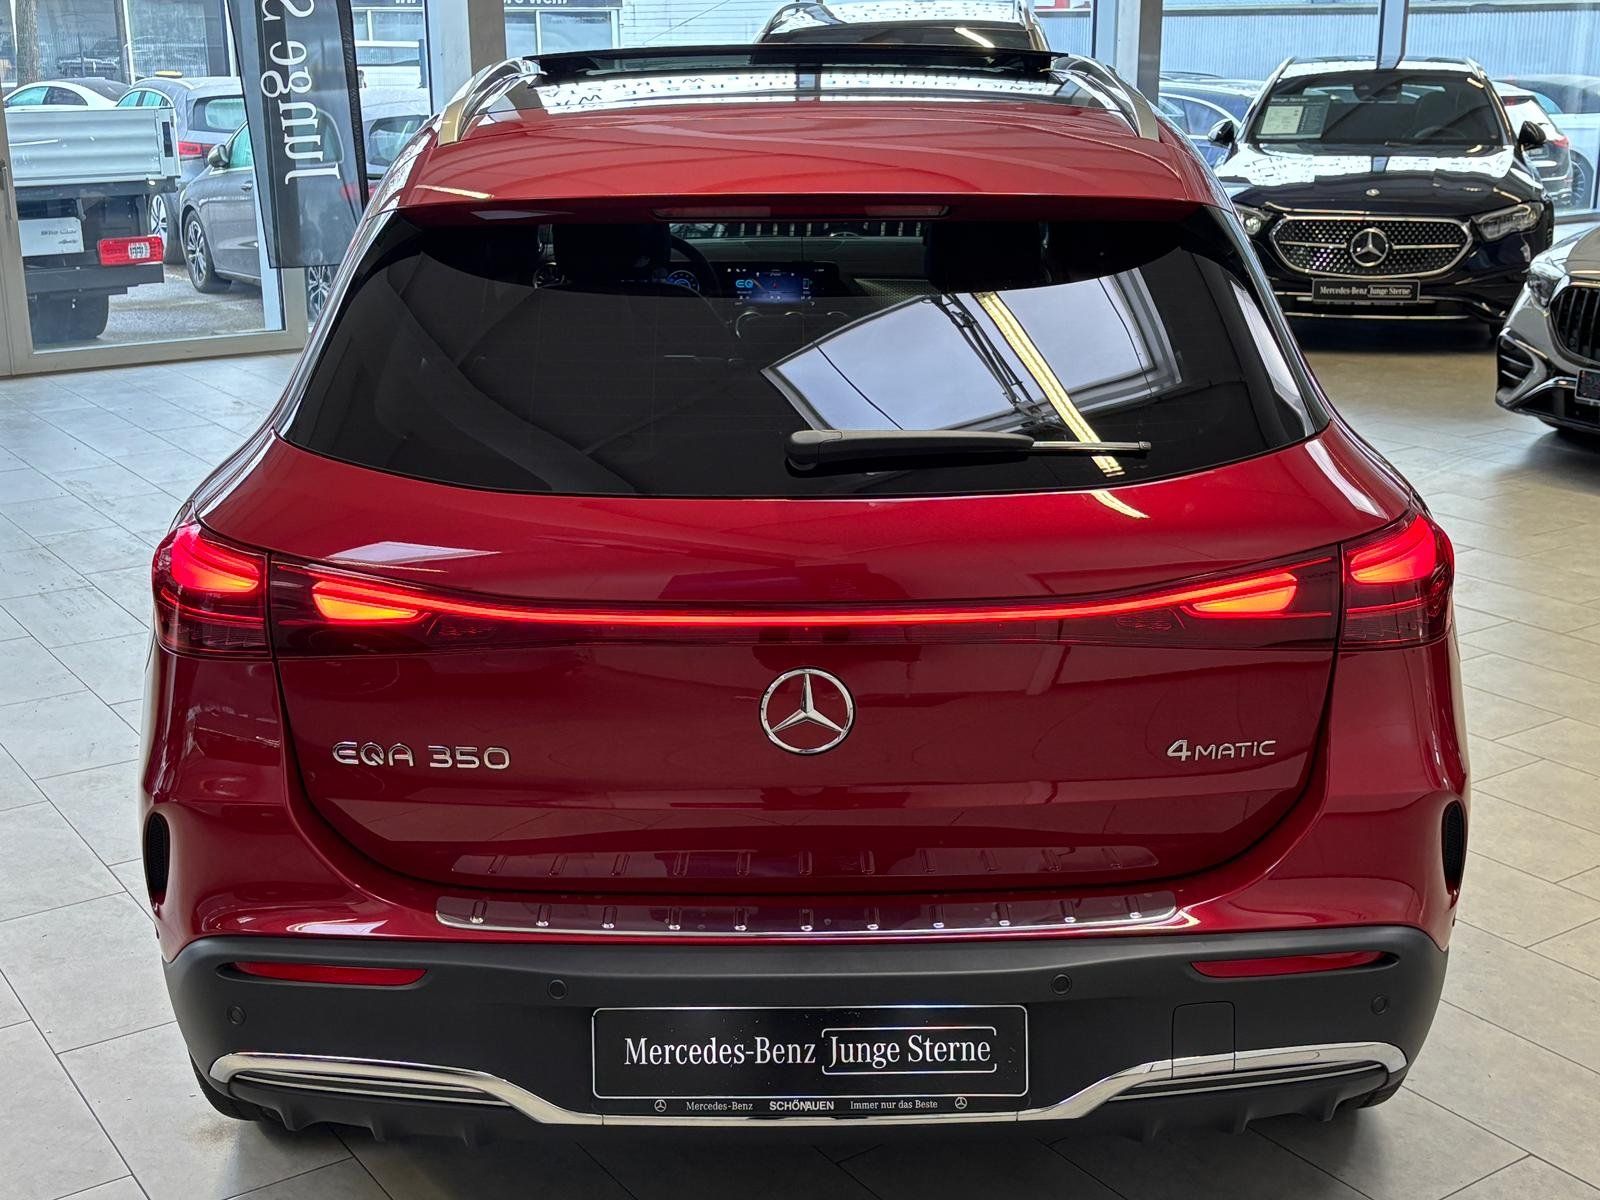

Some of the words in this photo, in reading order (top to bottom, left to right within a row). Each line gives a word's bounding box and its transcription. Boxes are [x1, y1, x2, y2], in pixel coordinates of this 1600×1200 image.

[735, 279, 754, 289] EQ
[332, 741, 415, 767] EQA
[427, 744, 511, 770] 350
[1166, 739, 1277, 762] 4MATIC
[624, 1036, 816, 1066] Mercedes-Benz
[828, 1036, 901, 1069] Junge
[907, 1034, 991, 1063] Sterne
[686, 1101, 754, 1111] Mercedes-Benz
[769, 1099, 835, 1111] SCHÖNAUEN
[850, 1101, 878, 1110] Immer
[881, 1101, 896, 1109] nur
[898, 1100, 913, 1109] das
[915, 1100, 938, 1109] Beste
